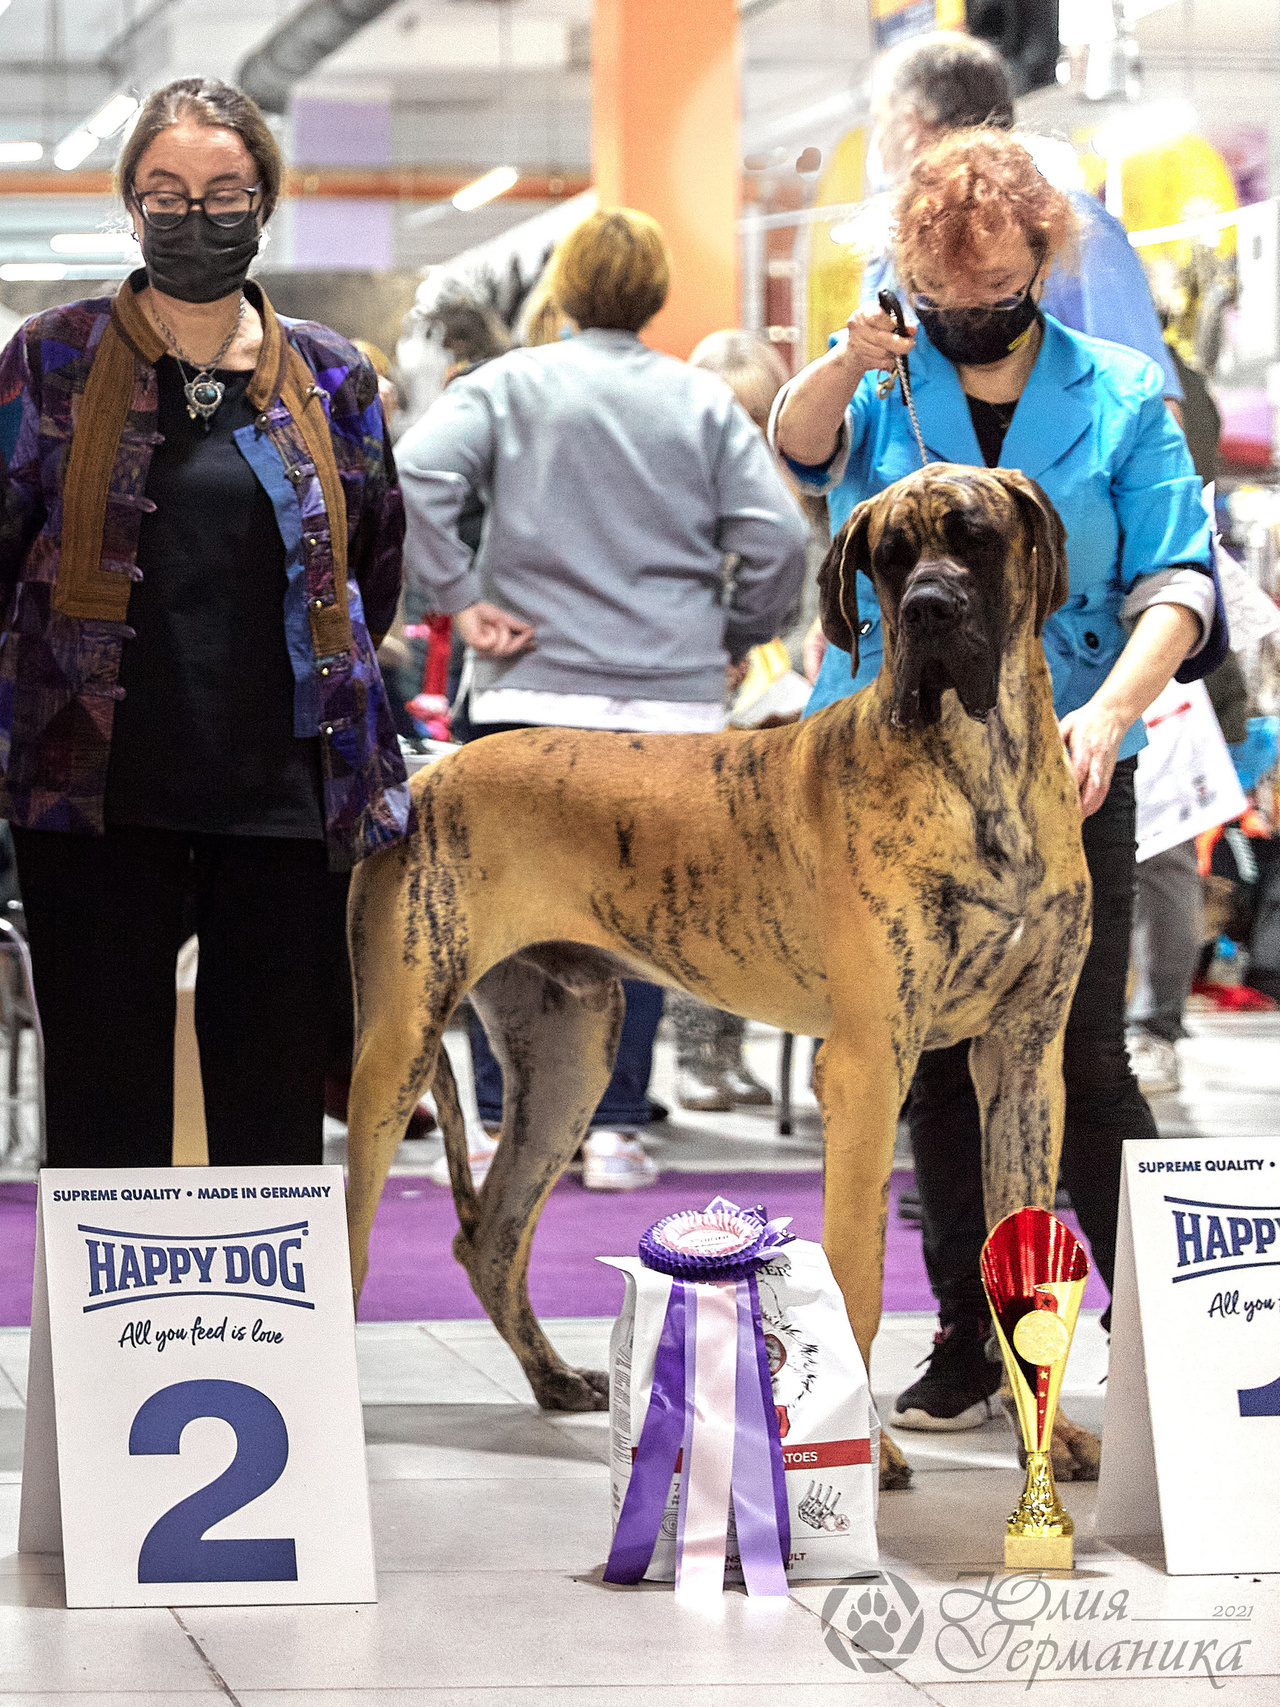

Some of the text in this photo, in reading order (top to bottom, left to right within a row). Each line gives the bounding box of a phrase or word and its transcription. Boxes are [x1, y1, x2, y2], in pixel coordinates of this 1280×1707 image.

[1138, 1159, 1264, 1173] SUPREME QUALITY
[53, 1186, 331, 1201] SUPREME QUALITY MADE IN GERMANY
[1172, 1210, 1280, 1268] HAPP
[85, 1237, 306, 1298] HAPPY DOG
[1207, 1289, 1275, 1322] All you
[117, 1316, 284, 1353] All you feed is love
[128, 1379, 299, 1584] 2
